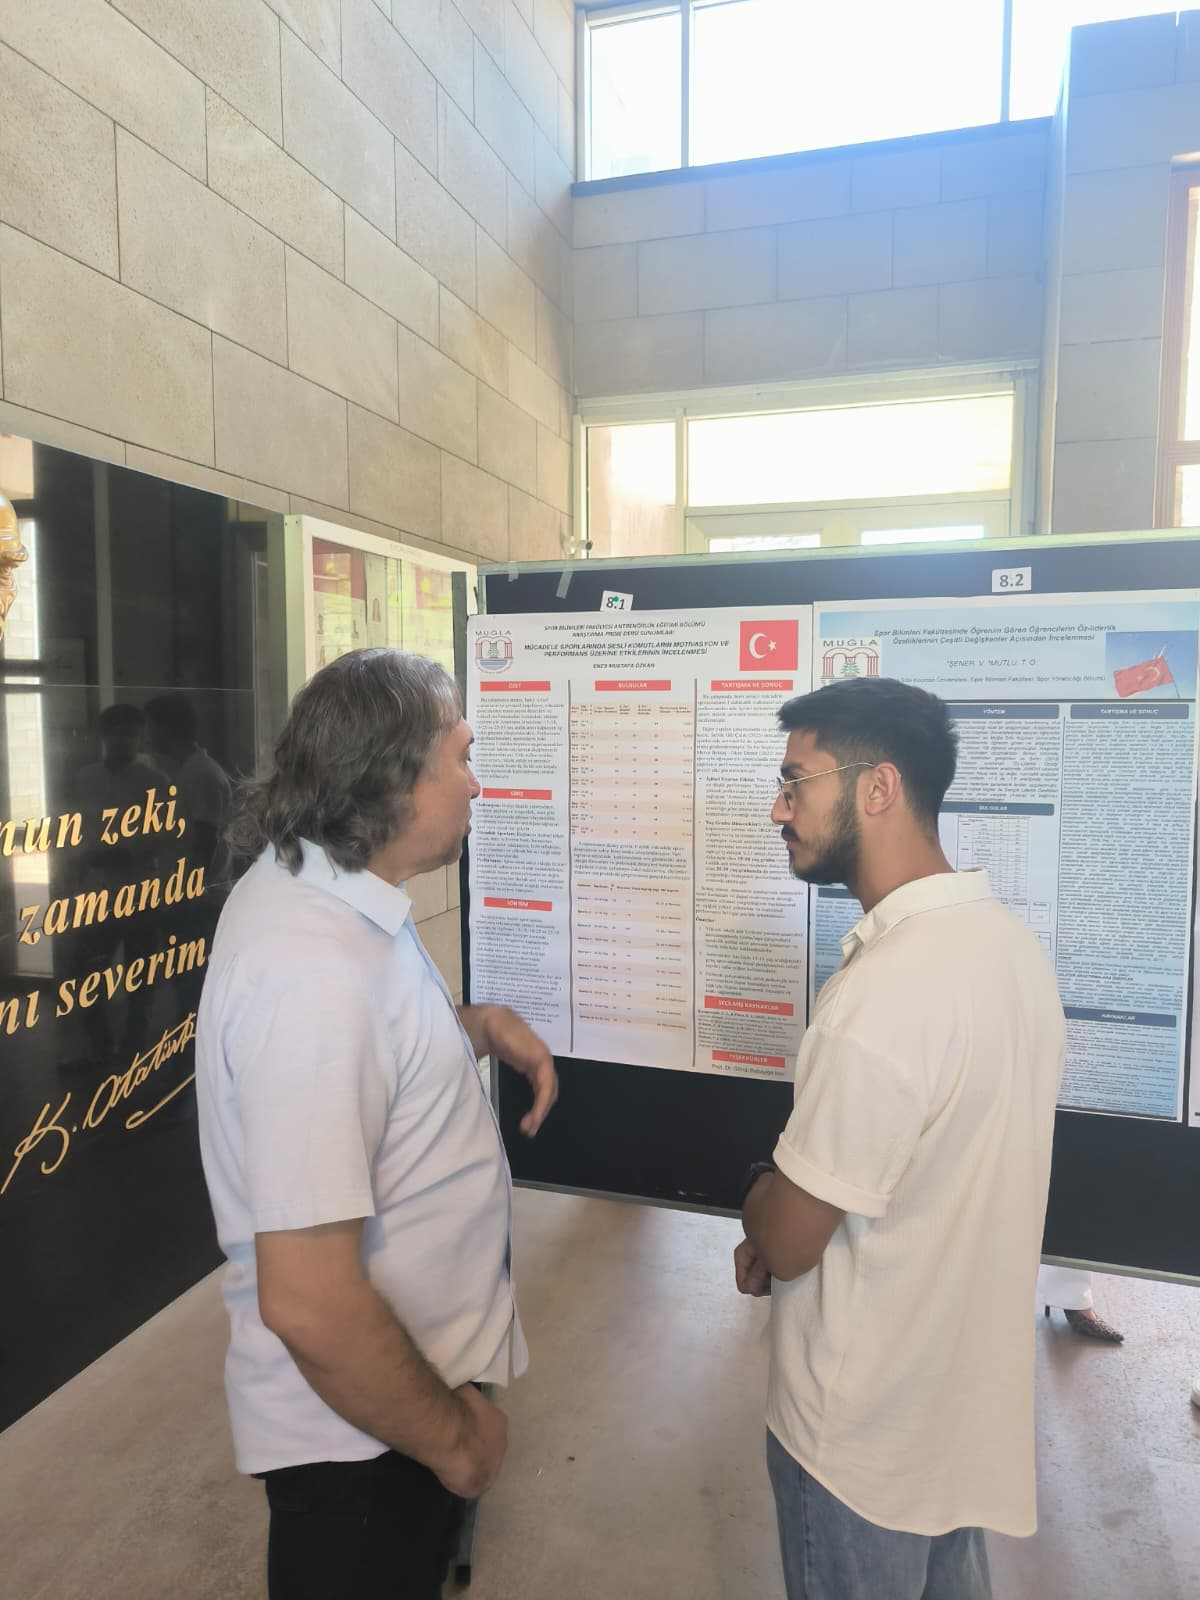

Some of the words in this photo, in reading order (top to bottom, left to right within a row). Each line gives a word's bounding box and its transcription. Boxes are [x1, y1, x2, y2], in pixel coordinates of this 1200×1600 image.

[1000, 573, 1024, 587] 8.2
[606, 596, 625, 610] 8.1
[874, 629, 890, 637] Spor
[970, 626, 1002, 636] Öğrenim
[1004, 626, 1027, 634] Gören
[100, 785, 186, 845] zeki,
[19, 857, 205, 945] zamanda
